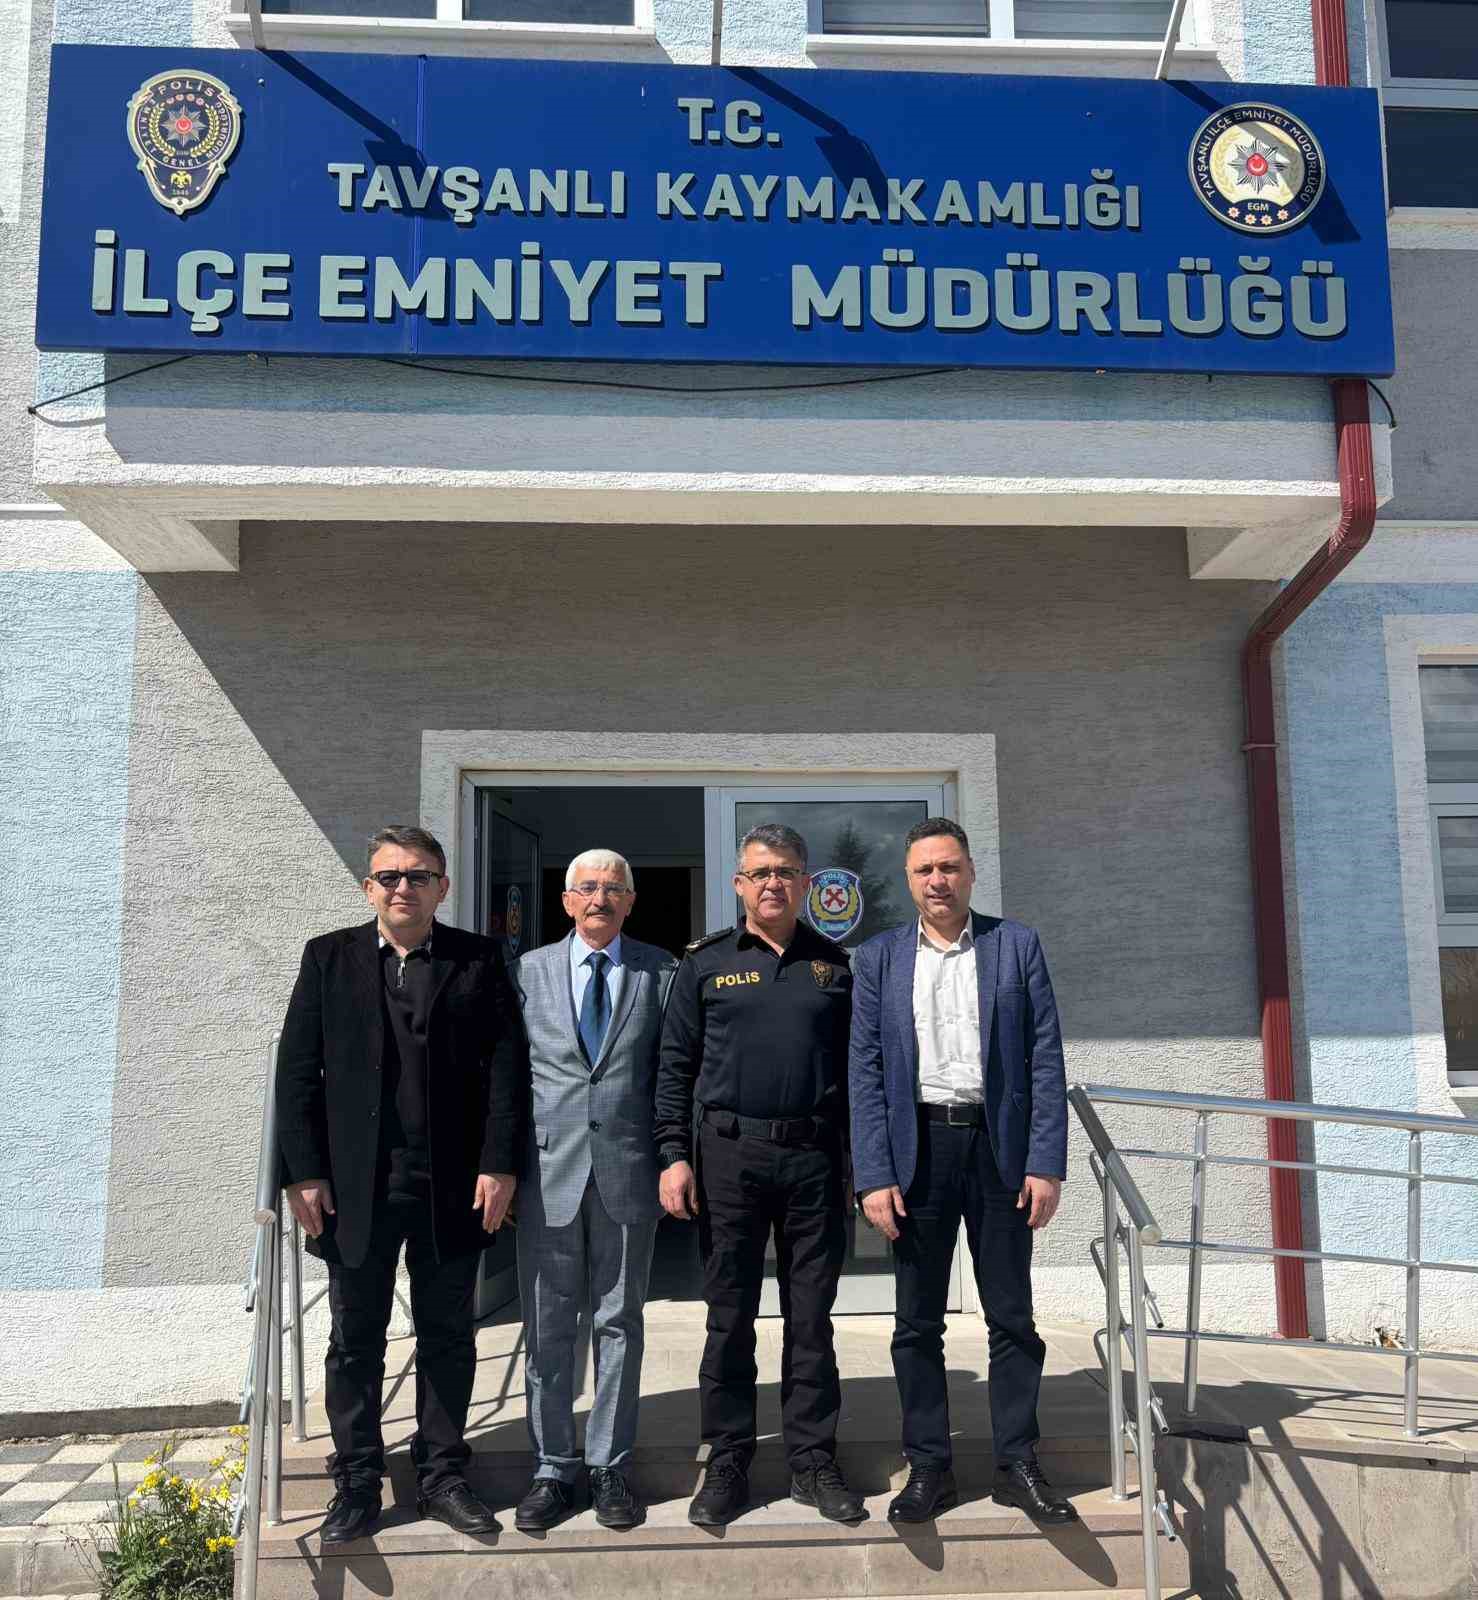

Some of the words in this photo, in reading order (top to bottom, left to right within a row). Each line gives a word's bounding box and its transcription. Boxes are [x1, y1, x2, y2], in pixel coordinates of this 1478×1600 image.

[158, 80, 215, 97] POLİS
[677, 98, 780, 143] T.C.
[162, 155, 202, 168] GENEL
[1197, 135, 1216, 198] TAVŞANLI
[1207, 117, 1232, 136] İLÇE
[1235, 110, 1289, 126] EMNİYET
[327, 163, 625, 223] TAVŞANLI
[656, 168, 1140, 228] KAYMAKAMLIĞI
[1247, 202, 1270, 212] EGM
[91, 230, 291, 333] İLÇE
[318, 241, 722, 325] EMNİYET
[791, 248, 1346, 338] MÜDÜRLÜĞÜ
[716, 972, 760, 988] POLİS
